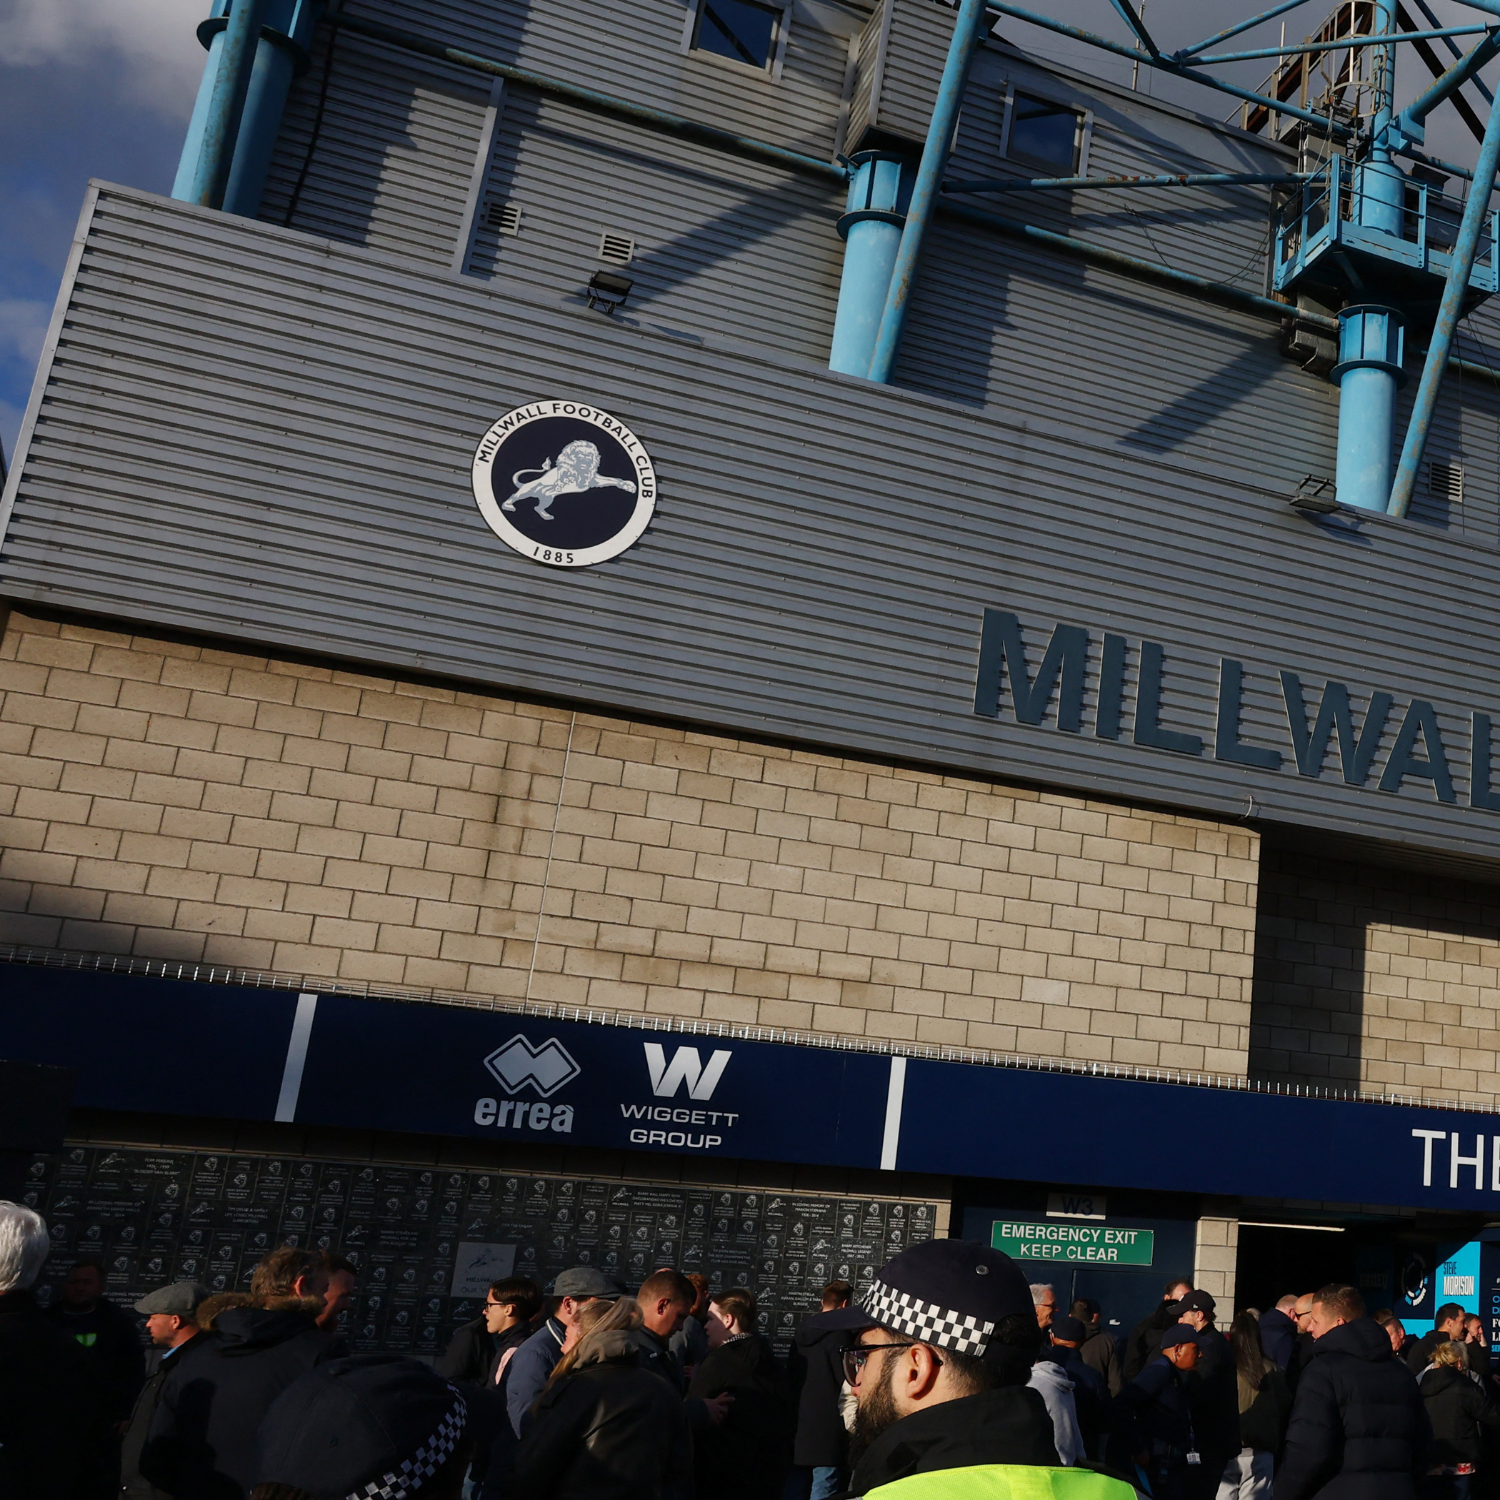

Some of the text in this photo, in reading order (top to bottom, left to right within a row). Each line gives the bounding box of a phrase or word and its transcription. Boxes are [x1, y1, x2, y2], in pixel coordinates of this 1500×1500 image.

[478, 403, 653, 498] MILLWALL FOOTBALL CLUB
[533, 546, 574, 564] 1885
[620, 1103, 739, 1127] WIGGETT
[629, 1128, 723, 1149] GROUP
[1061, 1196, 1094, 1216] W3
[1001, 1224, 1138, 1245] EMERGENCY EXIT
[1020, 1243, 1118, 1261] KEEP CLEAR
[1443, 1261, 1457, 1275] STEVE
[1443, 1275, 1474, 1296] MORISON
